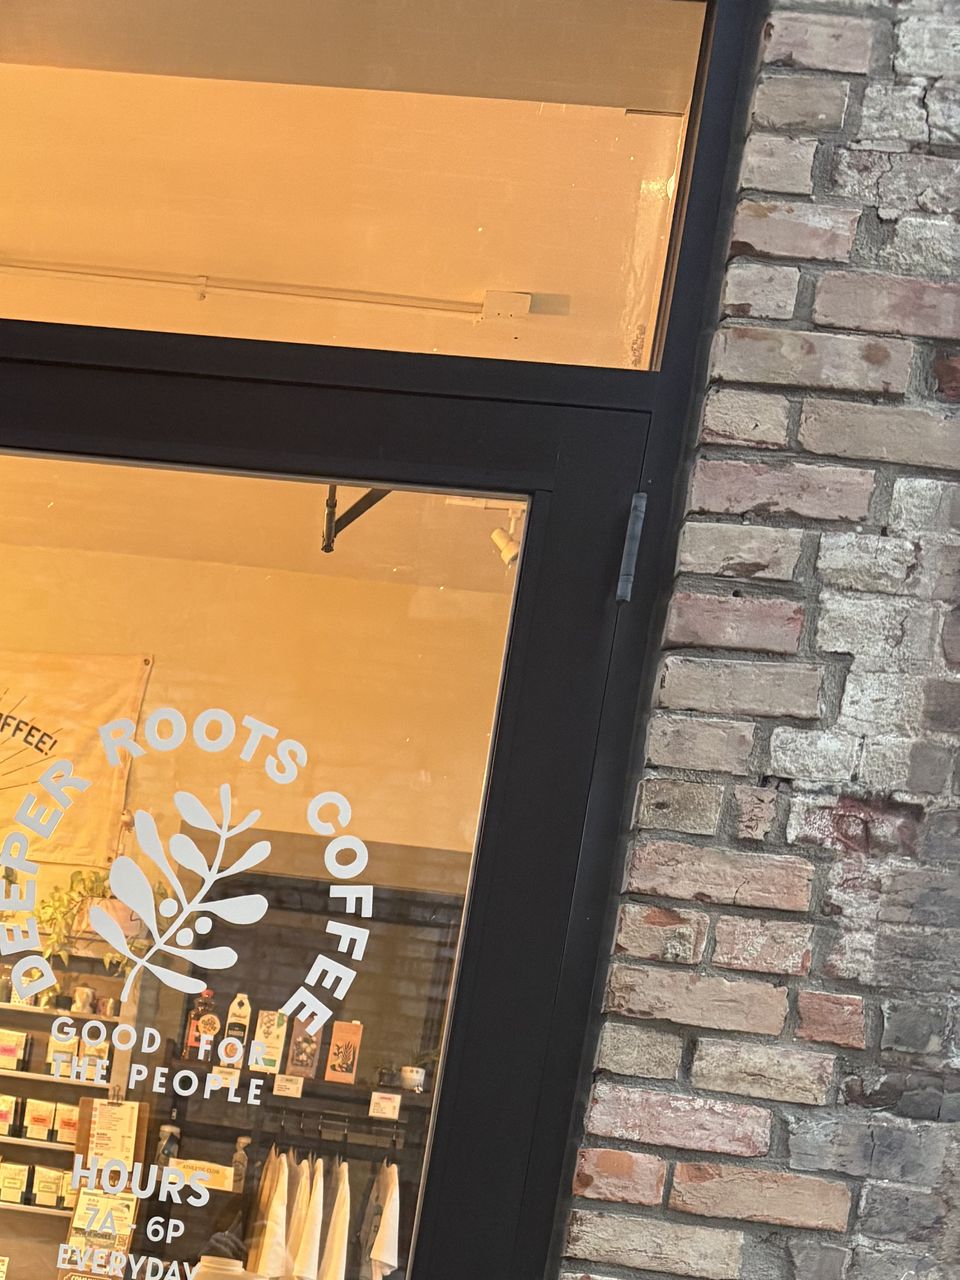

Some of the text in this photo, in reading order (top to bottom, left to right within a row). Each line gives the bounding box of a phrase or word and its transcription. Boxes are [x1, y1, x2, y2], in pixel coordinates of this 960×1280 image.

[98, 707, 308, 784] ROOTS
[279, 791, 374, 1036] COFFEE
[51, 1016, 161, 1054] GOOD
[197, 1033, 267, 1067] FOR
[53, 1053, 110, 1084] THE
[128, 1063, 264, 1106] PEOPLE
[70, 1153, 210, 1207] HOURS
[84, 1206, 117, 1236] 7A
[146, 1215, 185, 1244] 6P
